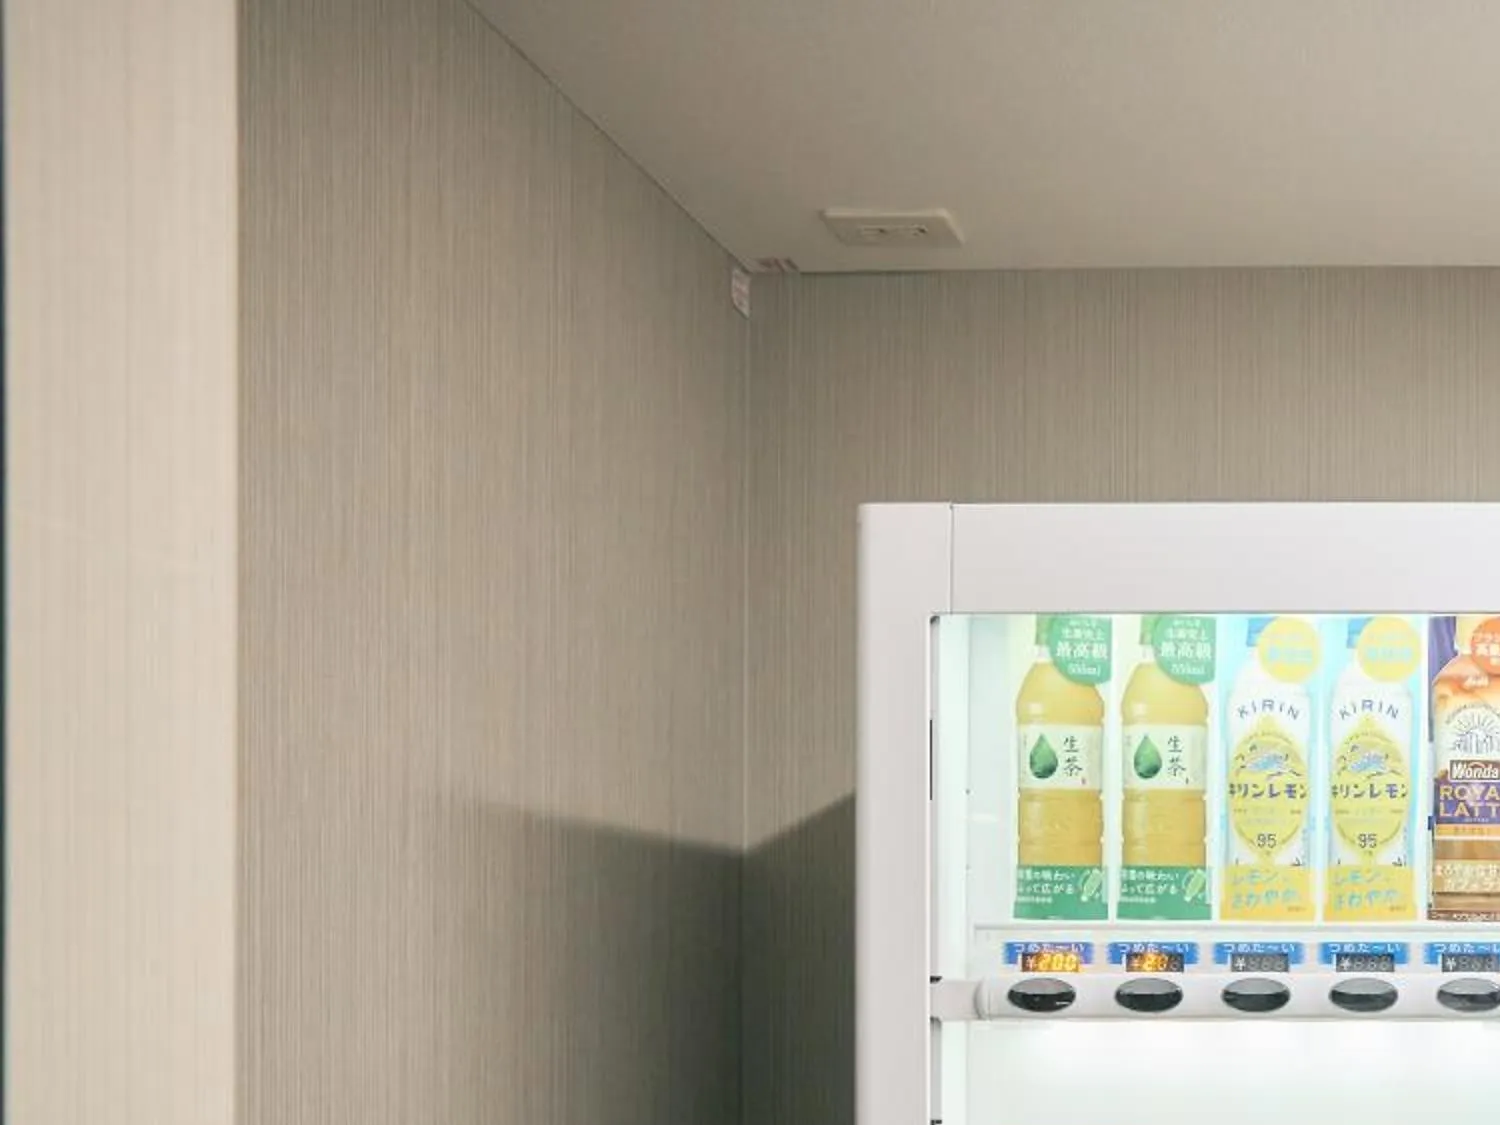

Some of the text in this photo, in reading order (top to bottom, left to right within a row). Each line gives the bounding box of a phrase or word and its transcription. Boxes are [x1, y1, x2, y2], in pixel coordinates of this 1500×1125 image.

[1237, 699, 1300, 720] KIRIN
[1339, 699, 1400, 720] KIRIN
[1063, 735, 1083, 778] 生茶
[1168, 735, 1187, 778] 生茶
[1257, 833, 1277, 848] 95
